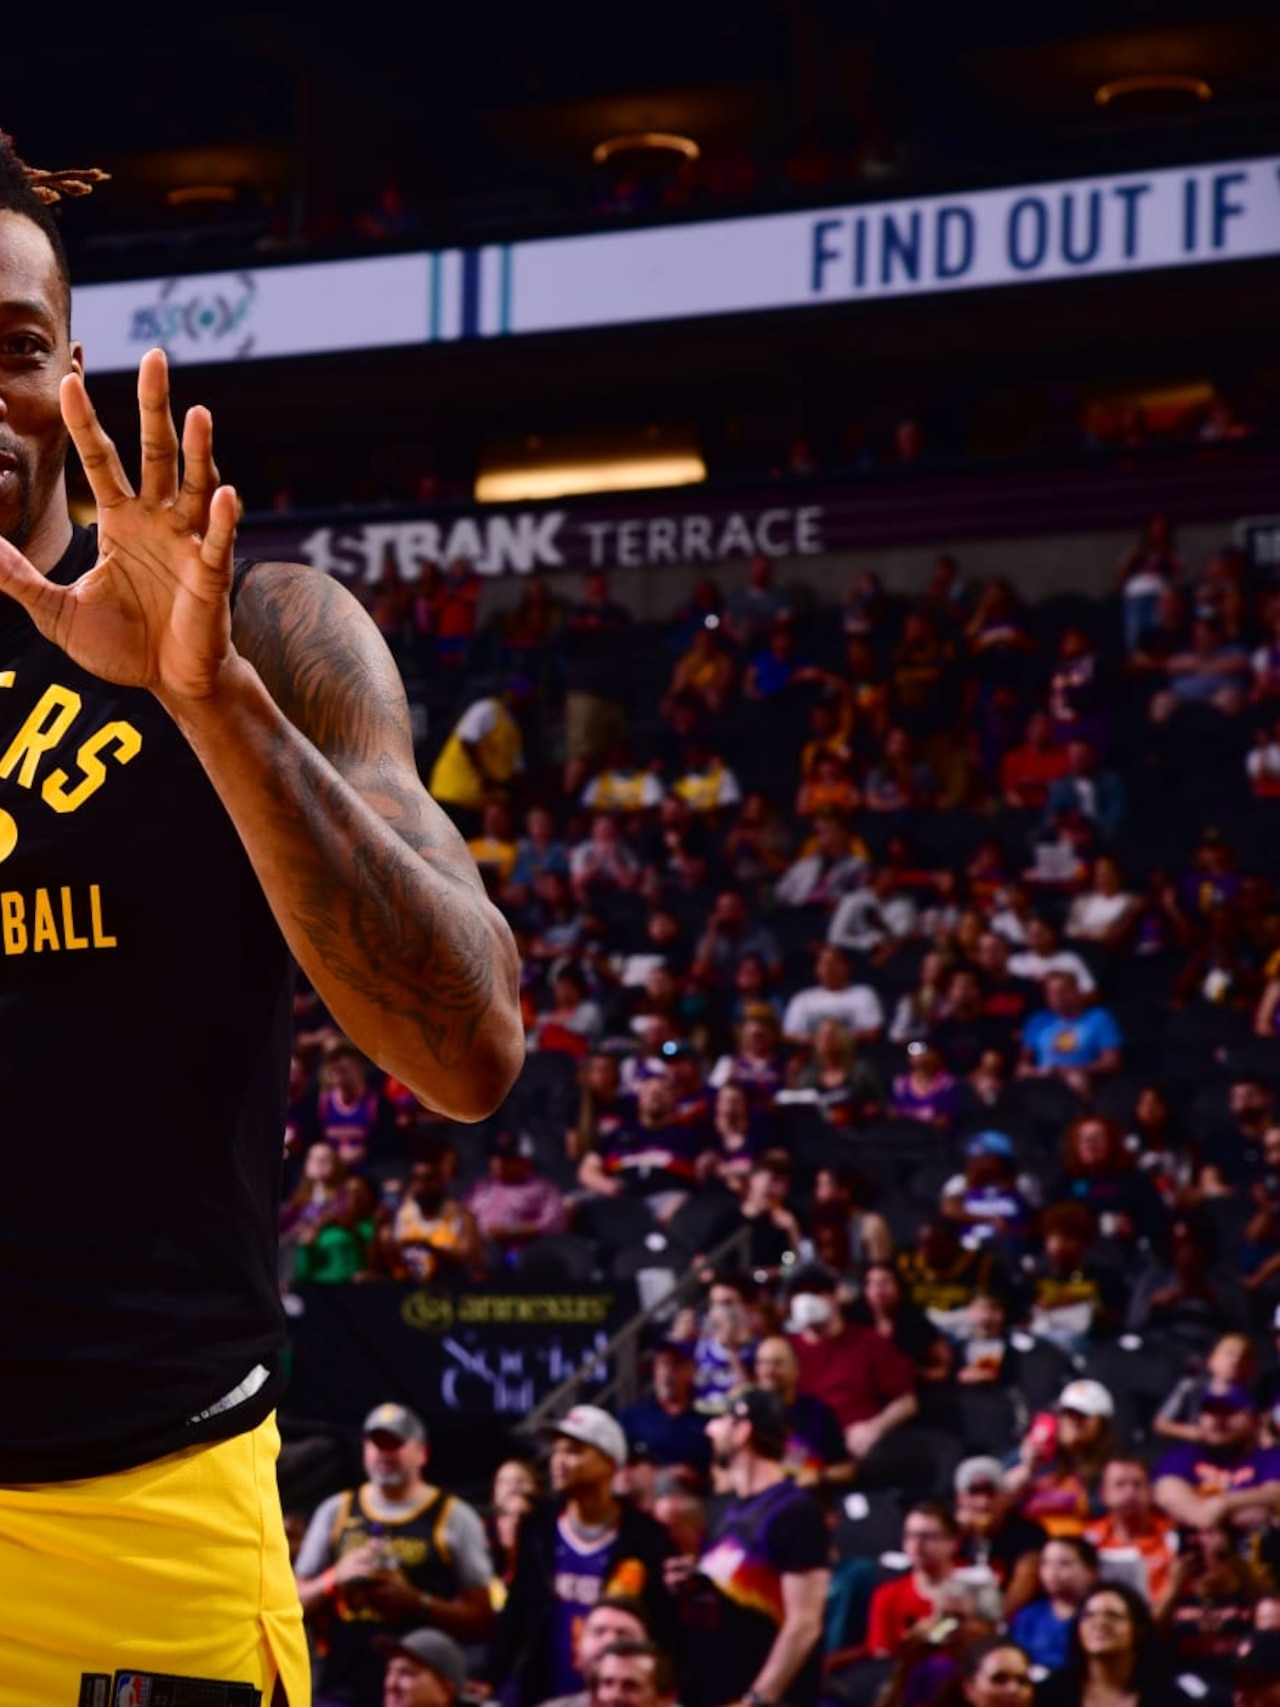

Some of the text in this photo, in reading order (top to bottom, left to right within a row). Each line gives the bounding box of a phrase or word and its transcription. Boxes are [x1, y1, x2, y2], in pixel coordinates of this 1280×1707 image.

[811, 206, 976, 293] FIND
[1006, 183, 1151, 271] OUT
[1184, 172, 1248, 251] IF
[579, 505, 823, 568] TERRACE
